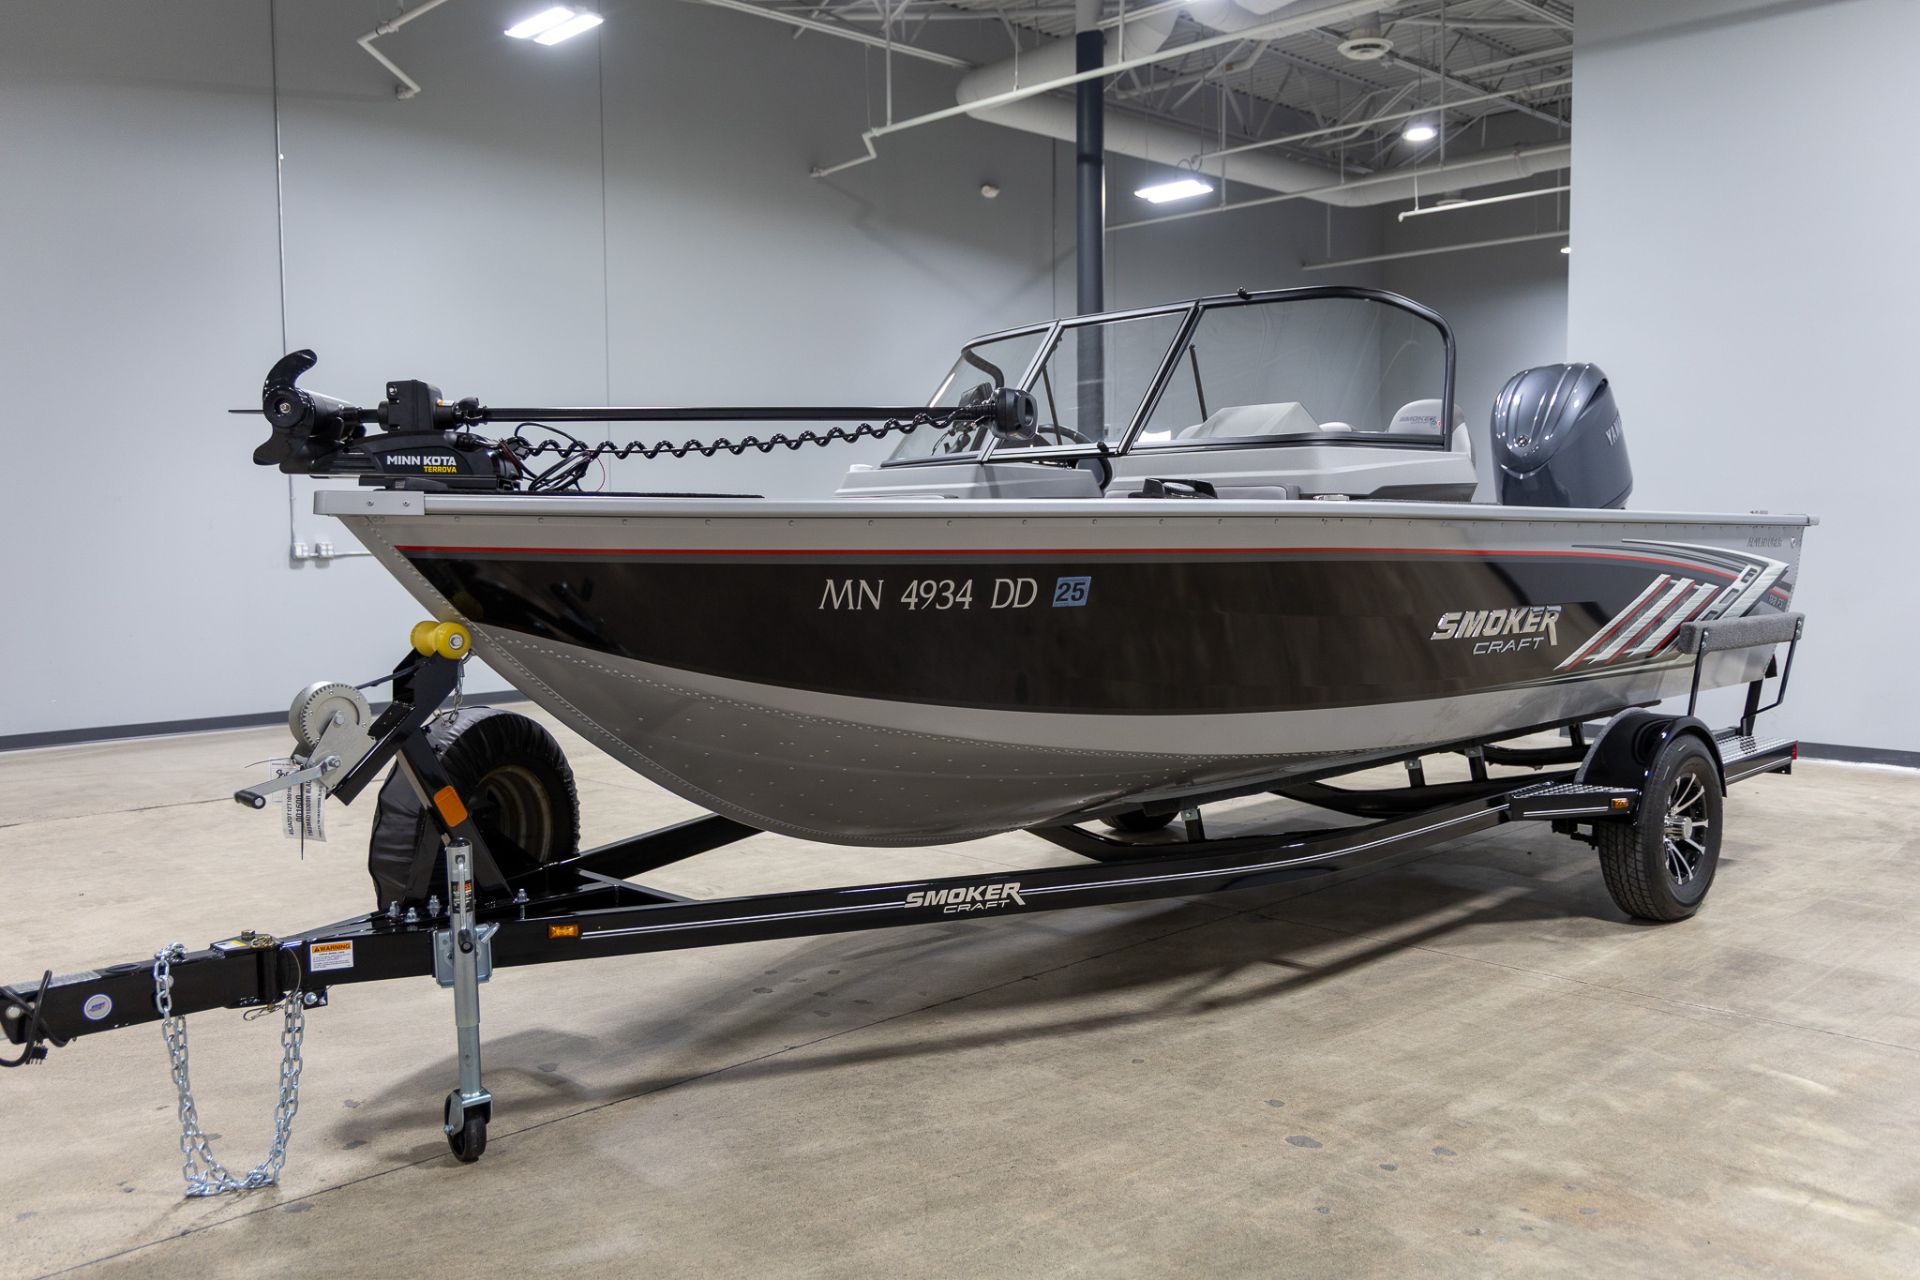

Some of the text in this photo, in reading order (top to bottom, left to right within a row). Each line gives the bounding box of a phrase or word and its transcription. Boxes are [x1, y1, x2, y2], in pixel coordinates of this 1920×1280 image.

[386, 455, 457, 466] MINN KOTA
[818, 577, 1038, 610] MN 4934 DD
[1055, 582, 1085, 602] 25
[1430, 605, 1562, 646] SMOKER
[1473, 637, 1545, 655] CRAFT
[904, 882, 1026, 908] SMOKER
[944, 899, 1010, 914] CRAFT
